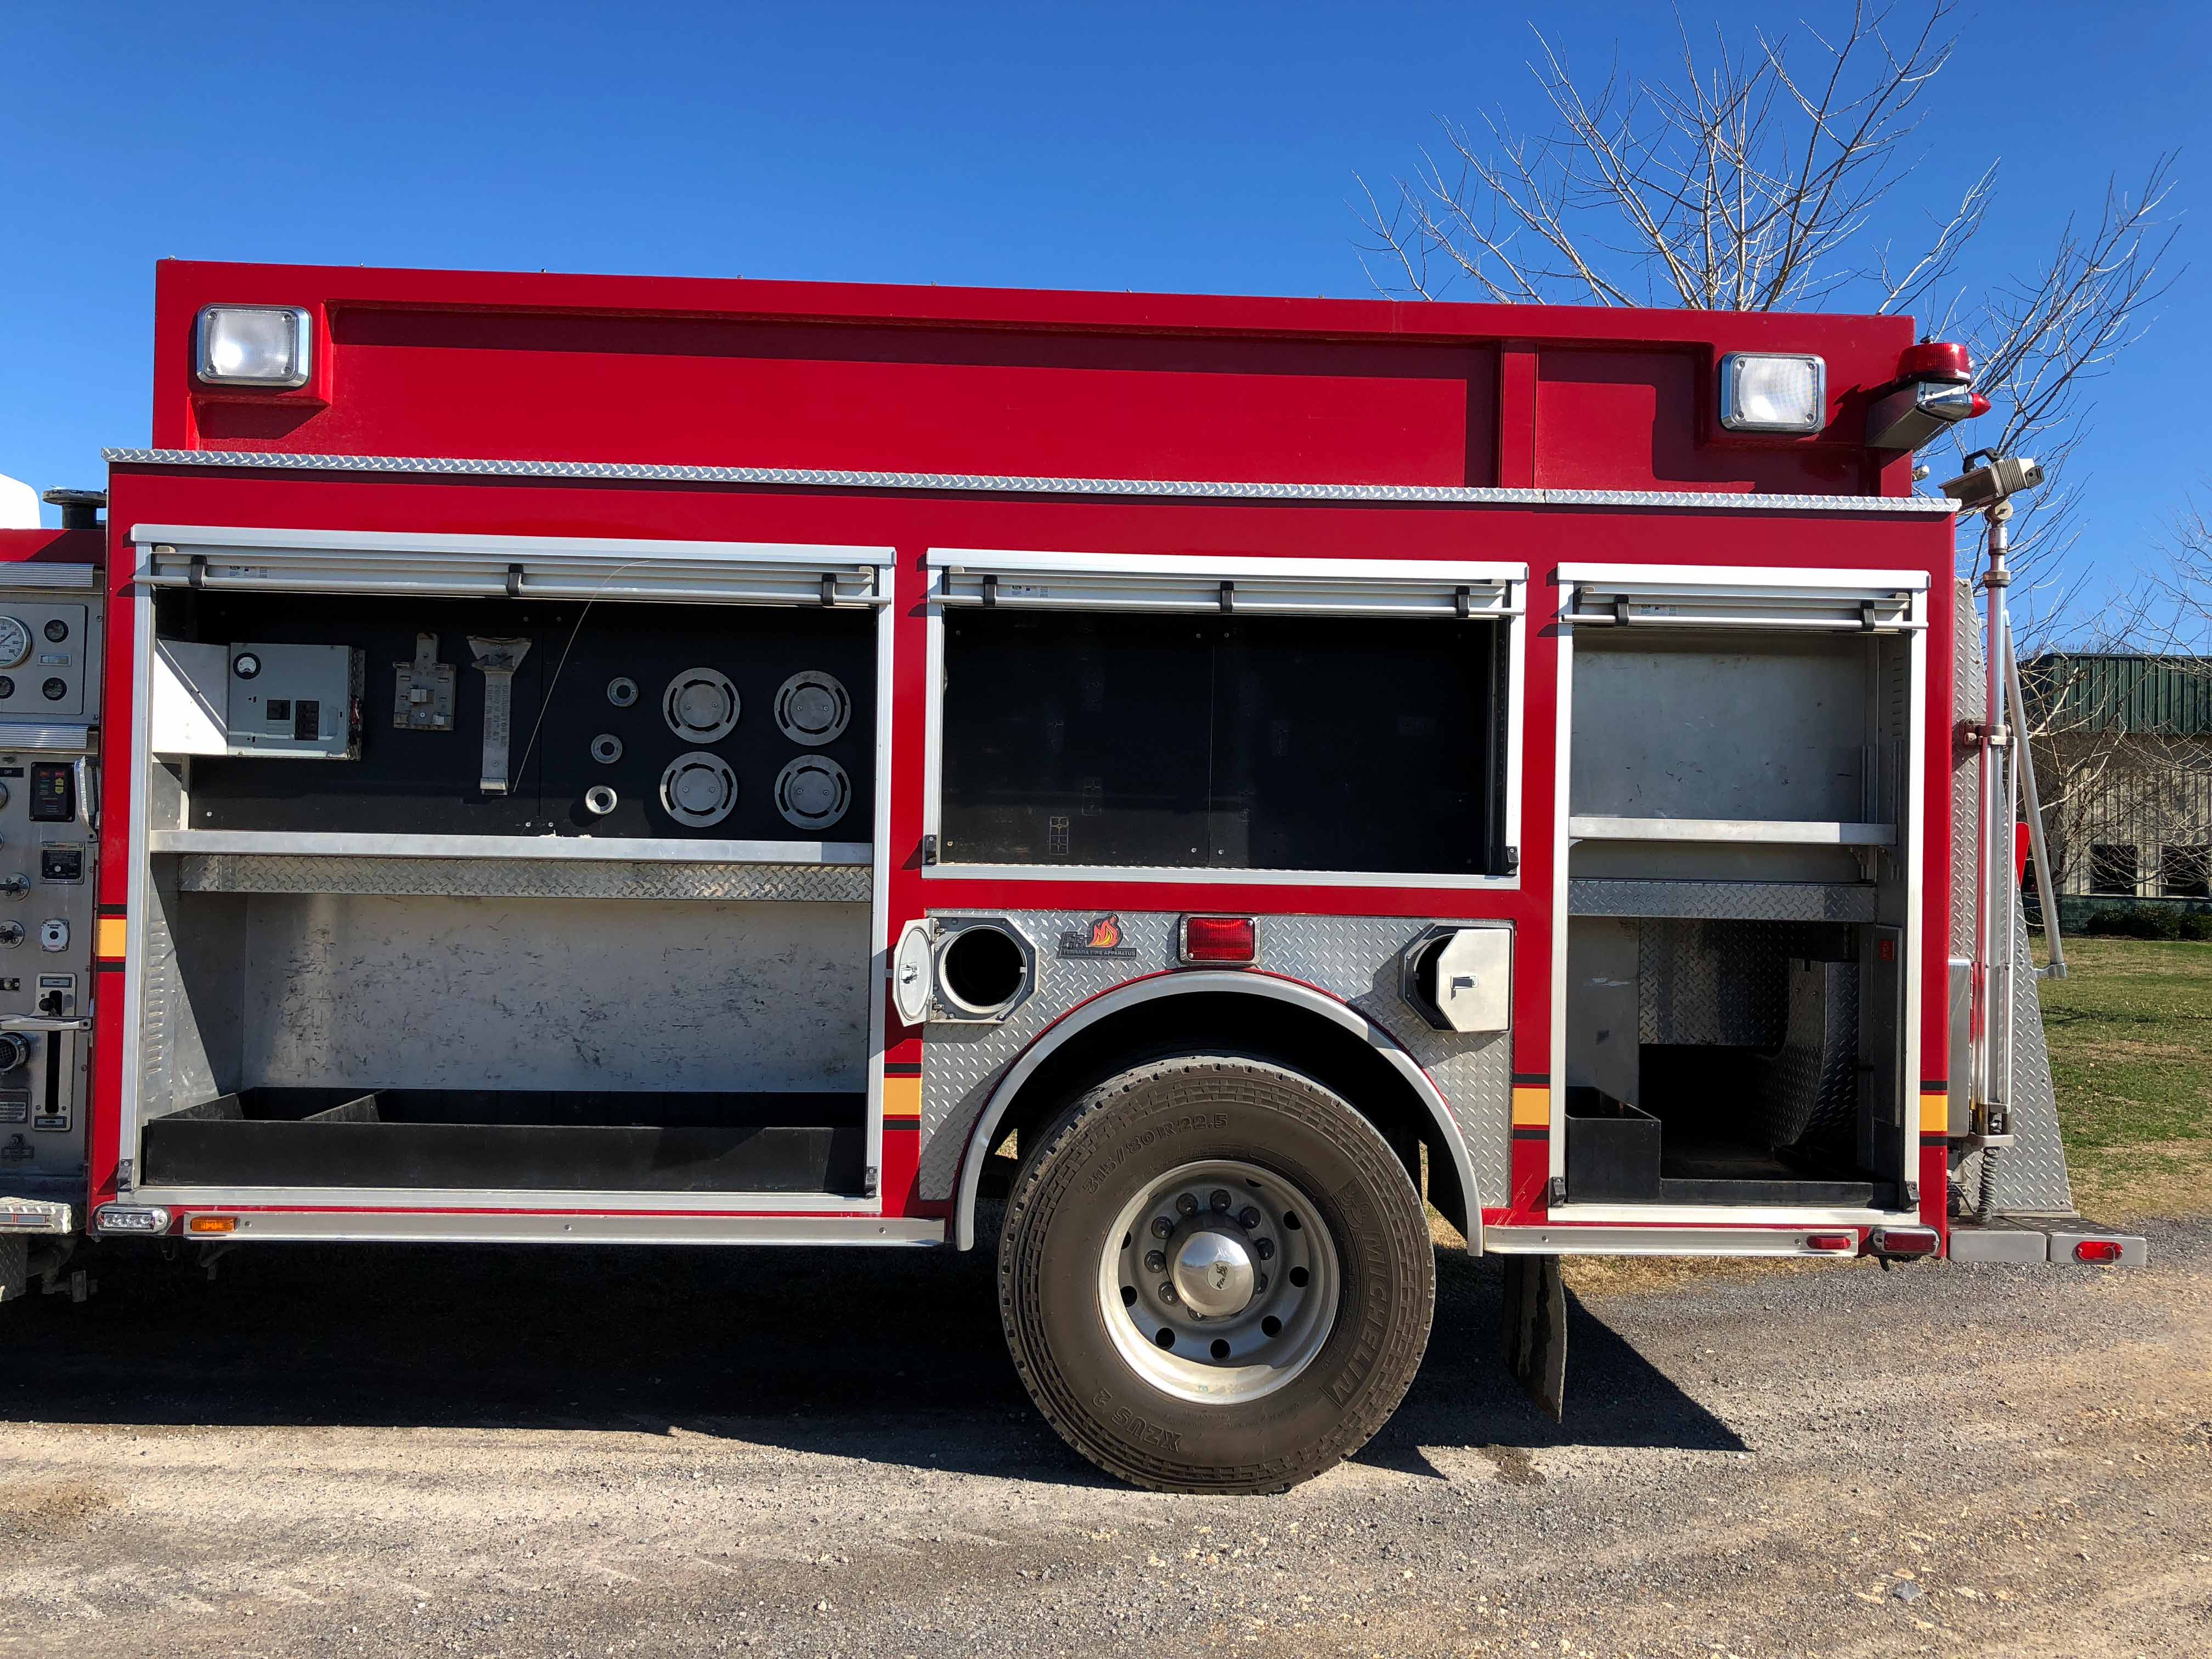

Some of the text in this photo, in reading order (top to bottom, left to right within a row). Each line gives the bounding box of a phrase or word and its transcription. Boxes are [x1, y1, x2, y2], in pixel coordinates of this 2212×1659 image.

[1332, 1232, 1388, 1403] MICHELIN
[1092, 1387, 1113, 1410] 2
[1110, 1406, 1182, 1453] XZUS
